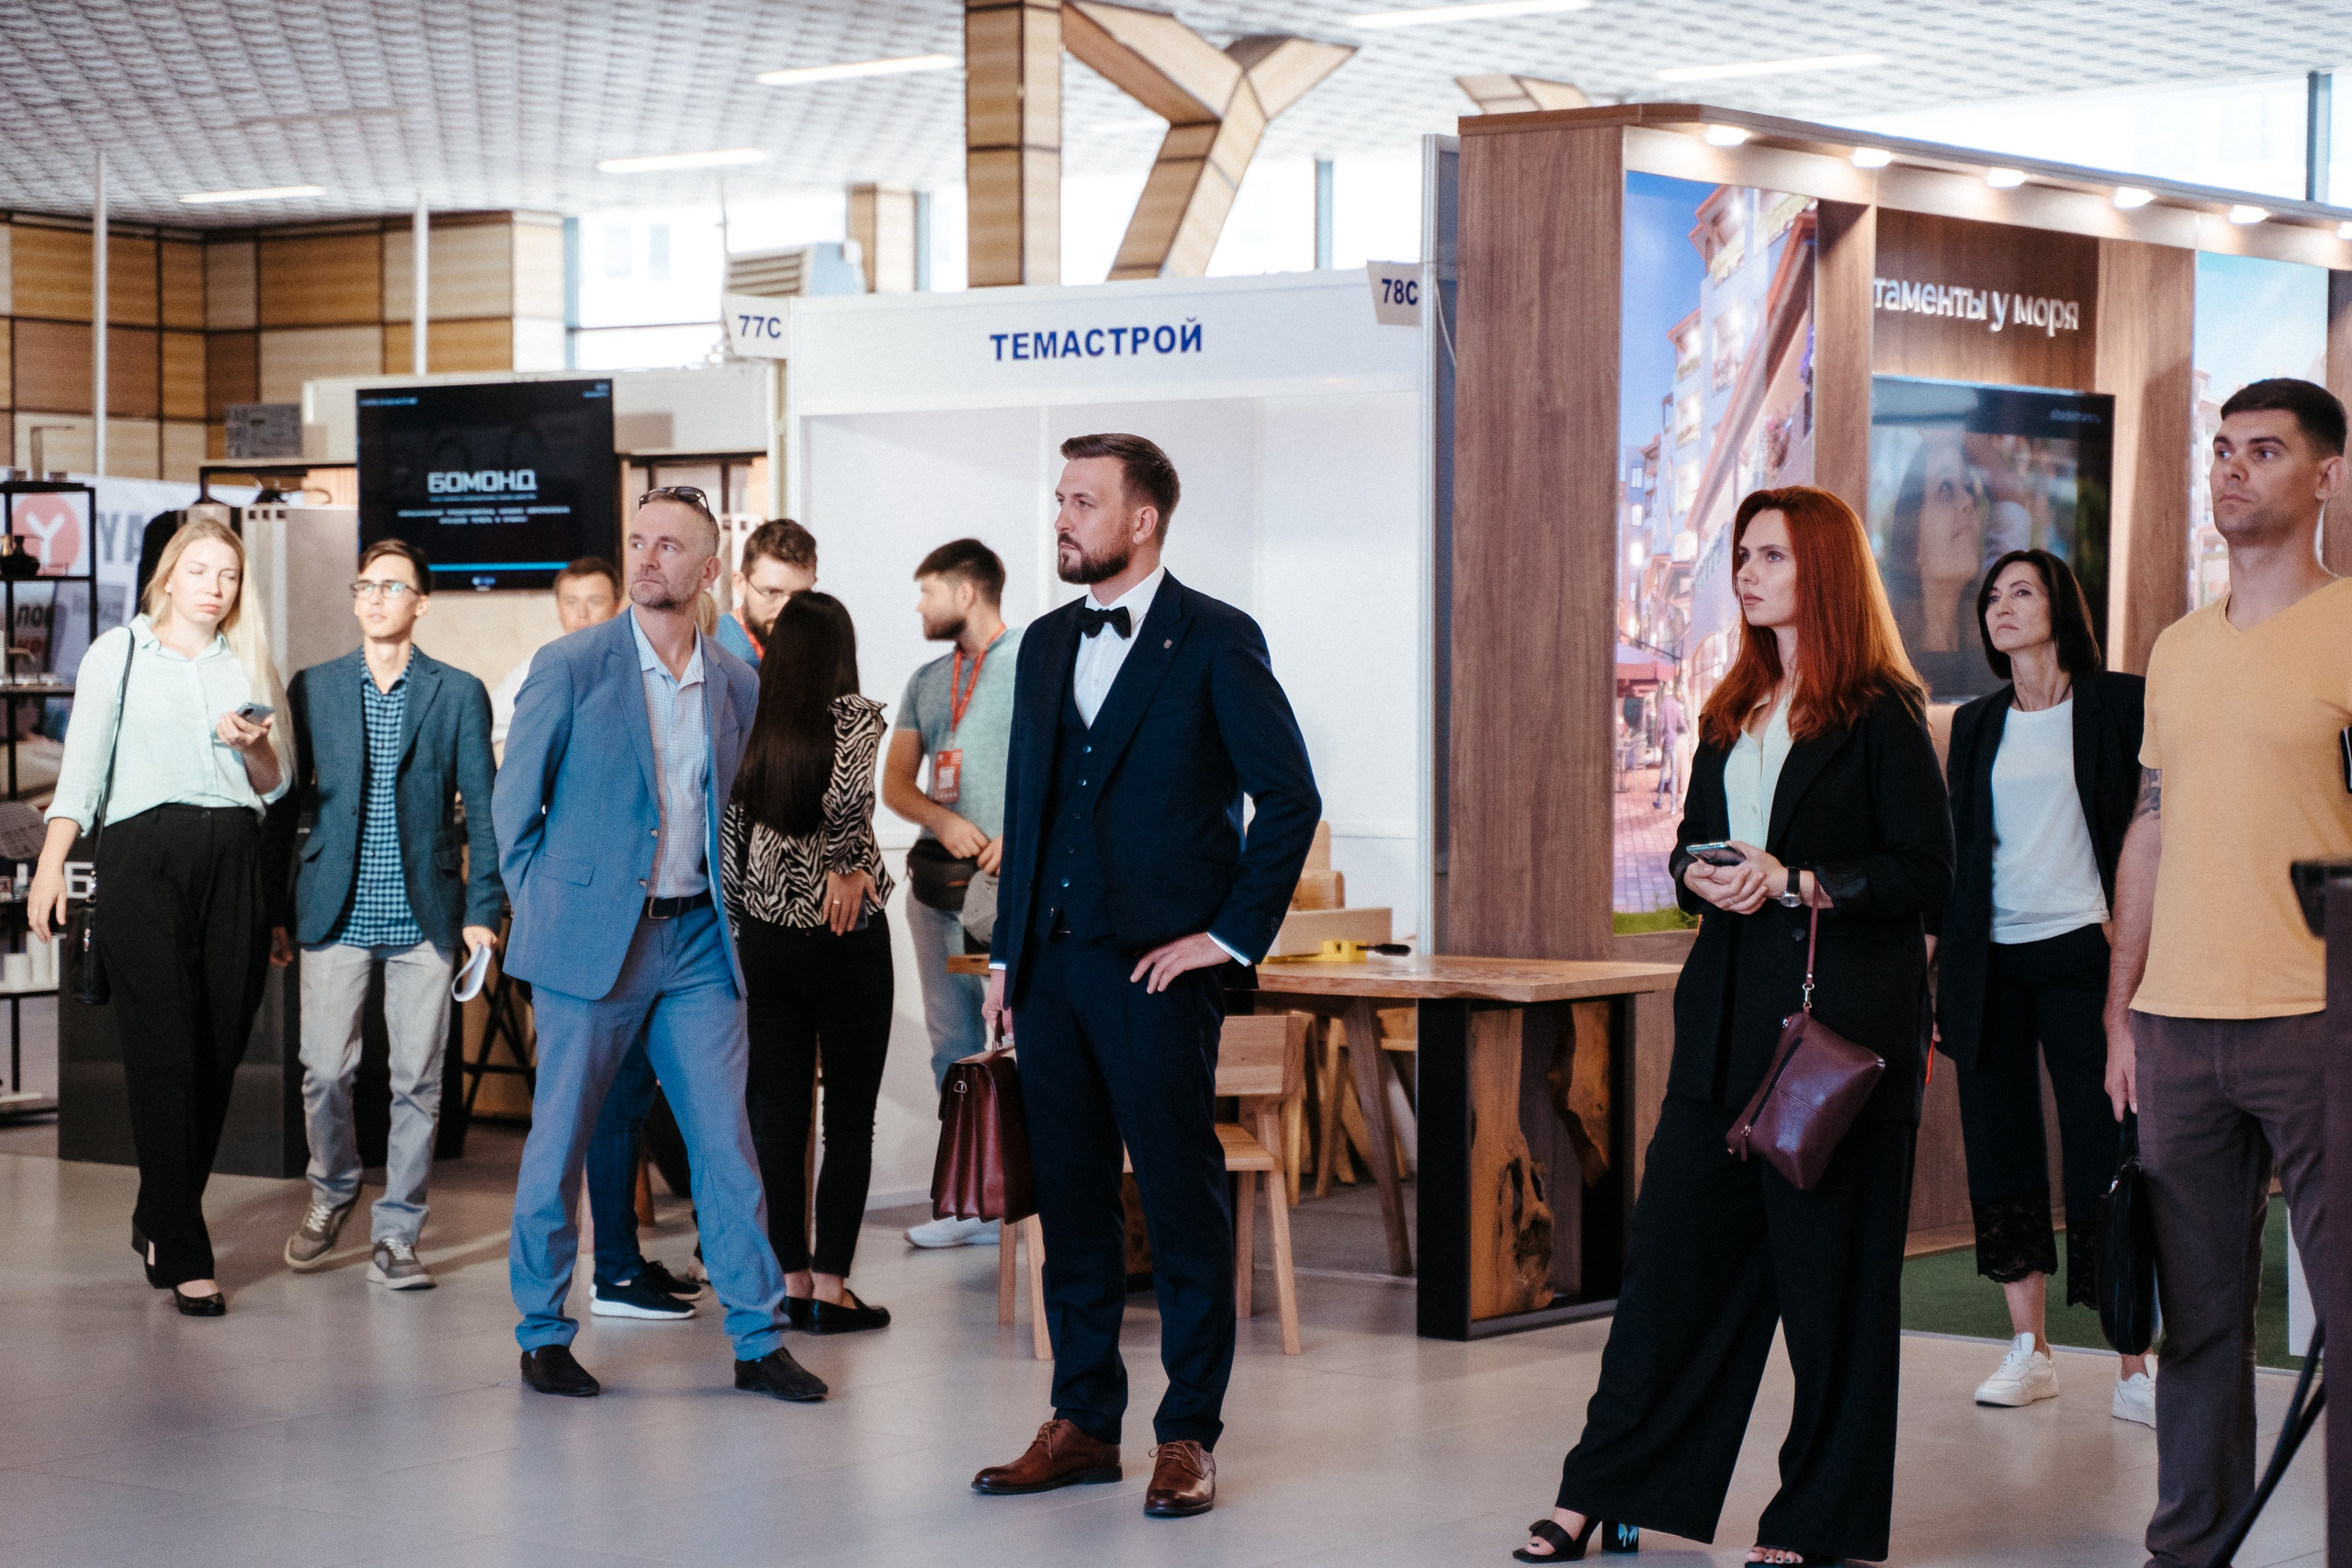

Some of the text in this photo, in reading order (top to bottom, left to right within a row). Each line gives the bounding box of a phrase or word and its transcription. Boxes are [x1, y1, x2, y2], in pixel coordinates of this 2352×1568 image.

[1381, 278, 1419, 306] 78C
[738, 315, 781, 339] 77C
[1990, 290, 2009, 332] у
[2013, 294, 2079, 337] моря
[989, 317, 1203, 361] ТЕМАСТРОЙ
[427, 469, 537, 493] БОМОНД
